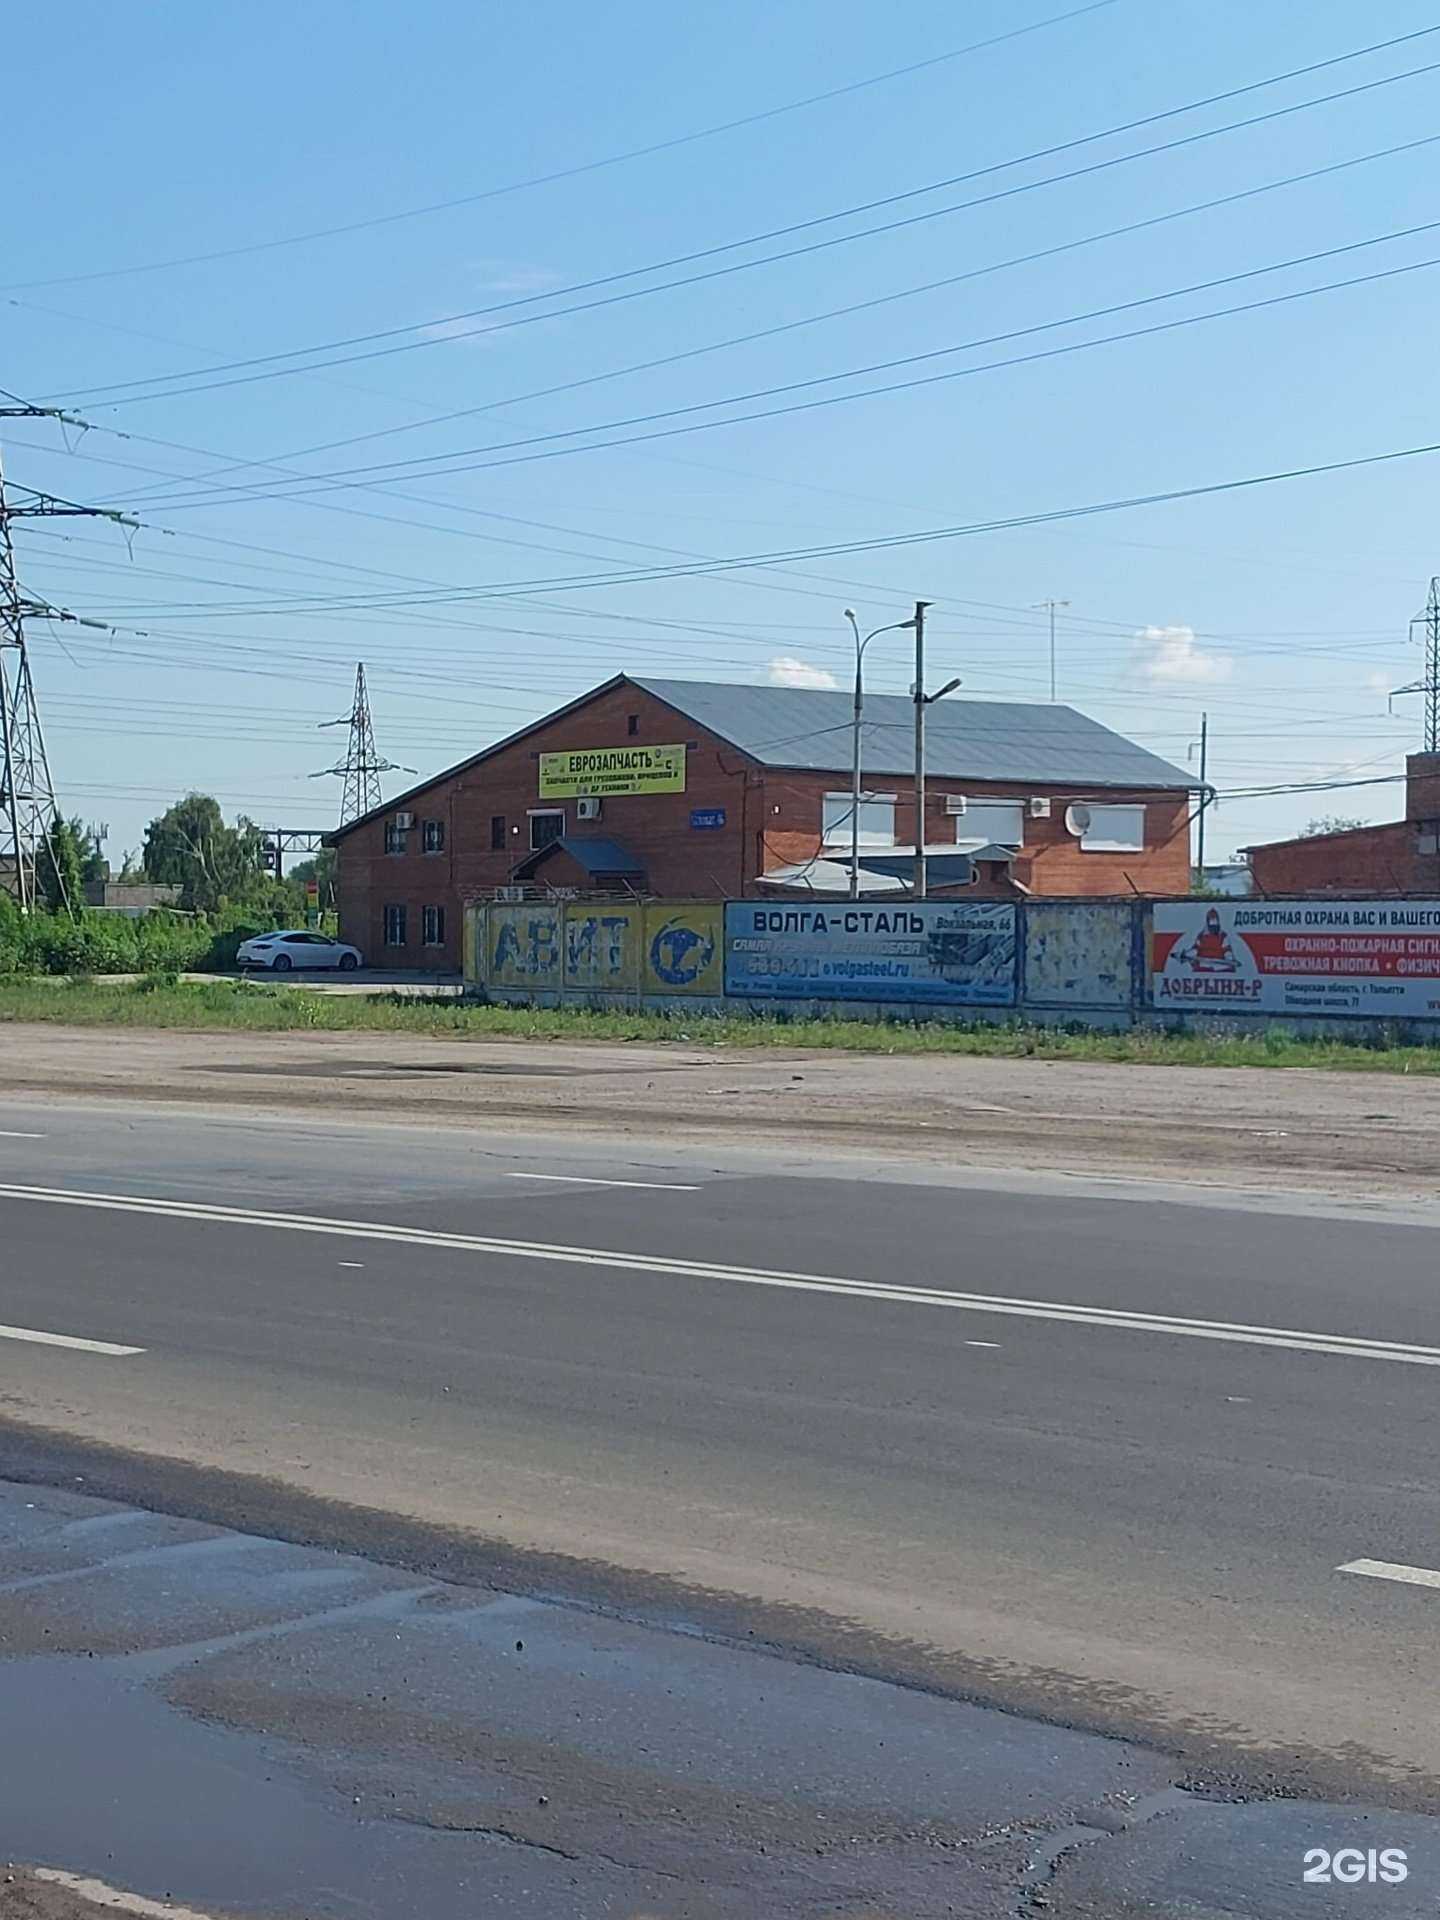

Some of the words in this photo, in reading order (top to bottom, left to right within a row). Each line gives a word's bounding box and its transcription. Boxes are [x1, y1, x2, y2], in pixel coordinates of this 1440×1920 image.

[569, 752, 652, 772] ЕВРОЗАПЧАСТЬ
[753, 911, 924, 933] ВОЛГА-СТАЛЬ
[1234, 911, 1302, 926] ДОБРОТНАЯ
[1305, 911, 1349, 925] ОХРАНА
[1353, 911, 1376, 925] ВАС
[1379, 911, 1387, 925] И
[1391, 911, 1440, 925] ВАШЕГО
[1284, 938, 1405, 953] ОХРАННО-ПОЖАРНАЯ
[1408, 939, 1440, 953] СИГН
[1333, 956, 1380, 972] КНОПКА
[1160, 978, 1263, 998] ДОБРЫНЯ-Р
